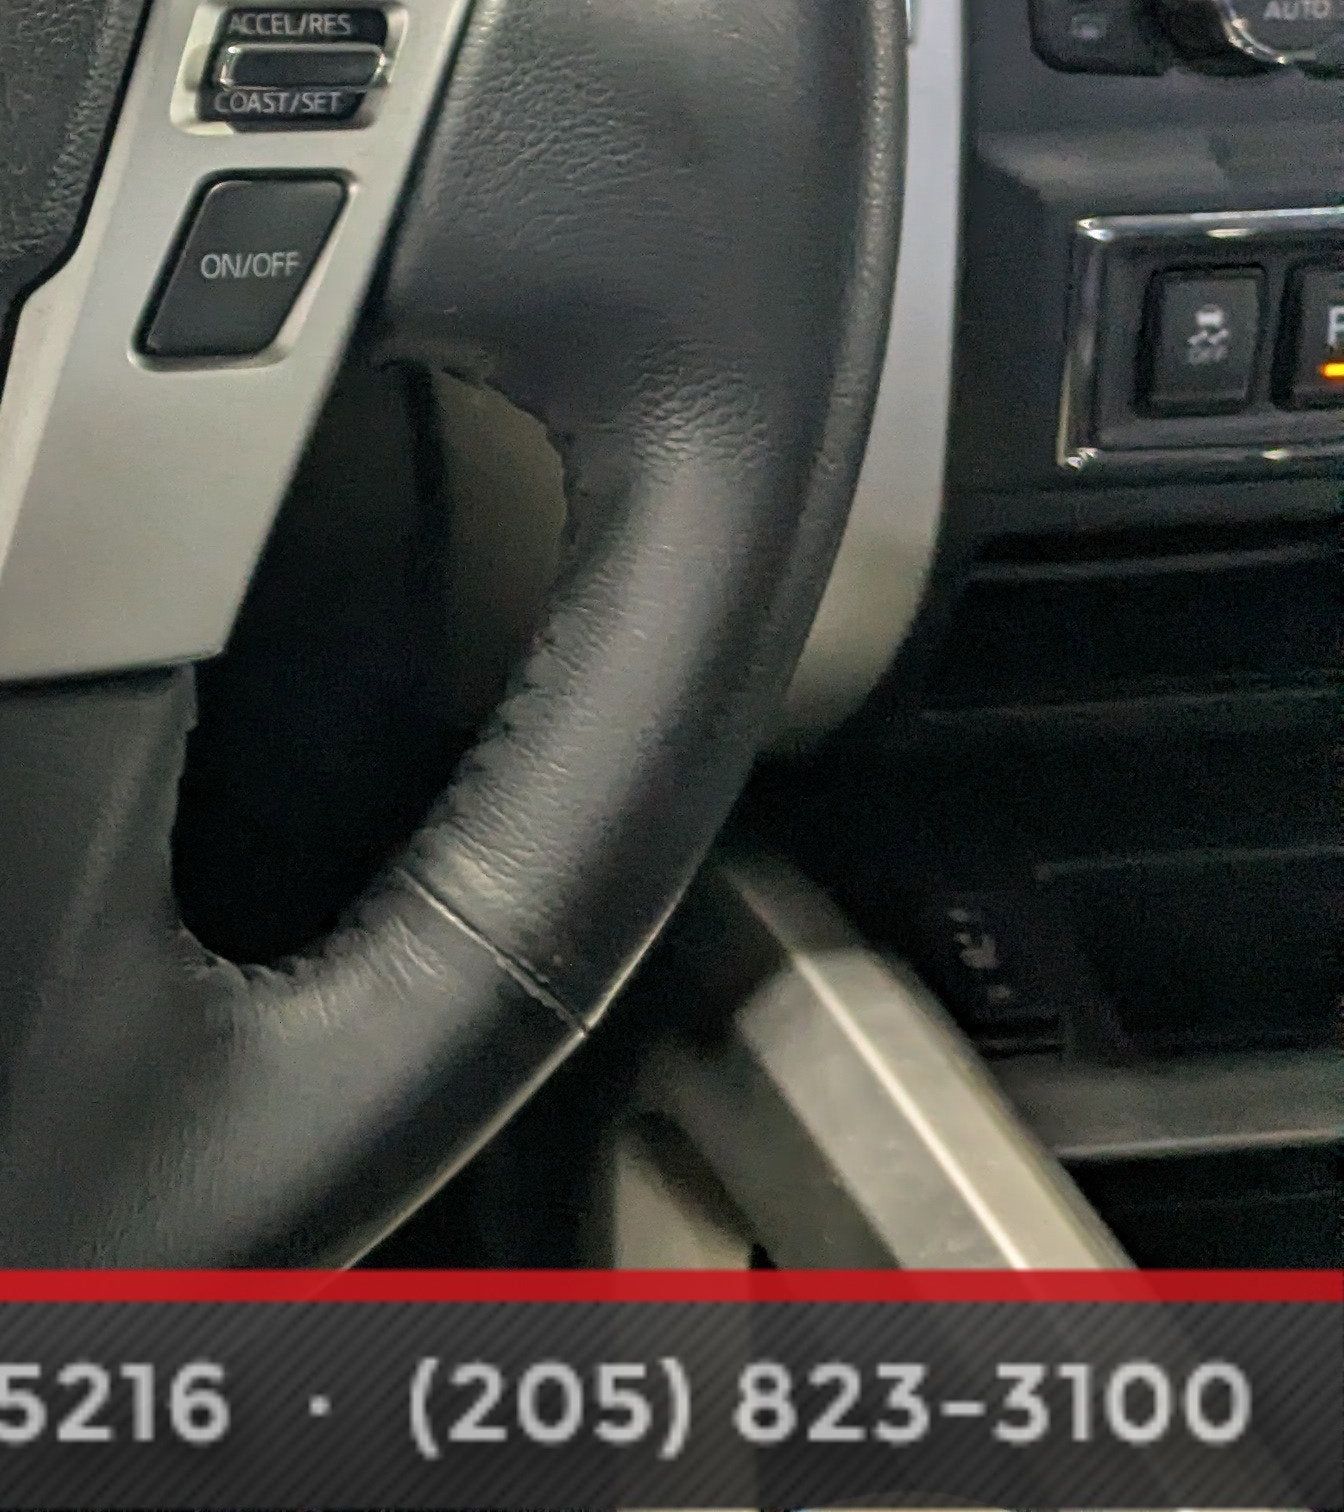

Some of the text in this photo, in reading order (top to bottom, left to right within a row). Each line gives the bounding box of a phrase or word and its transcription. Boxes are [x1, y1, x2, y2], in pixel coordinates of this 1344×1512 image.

[1263, 0, 1332, 21] AUTO
[228, 11, 353, 36] ACCEL/RES
[214, 89, 342, 115] COAST/SET
[200, 249, 302, 279] ON/OFF
